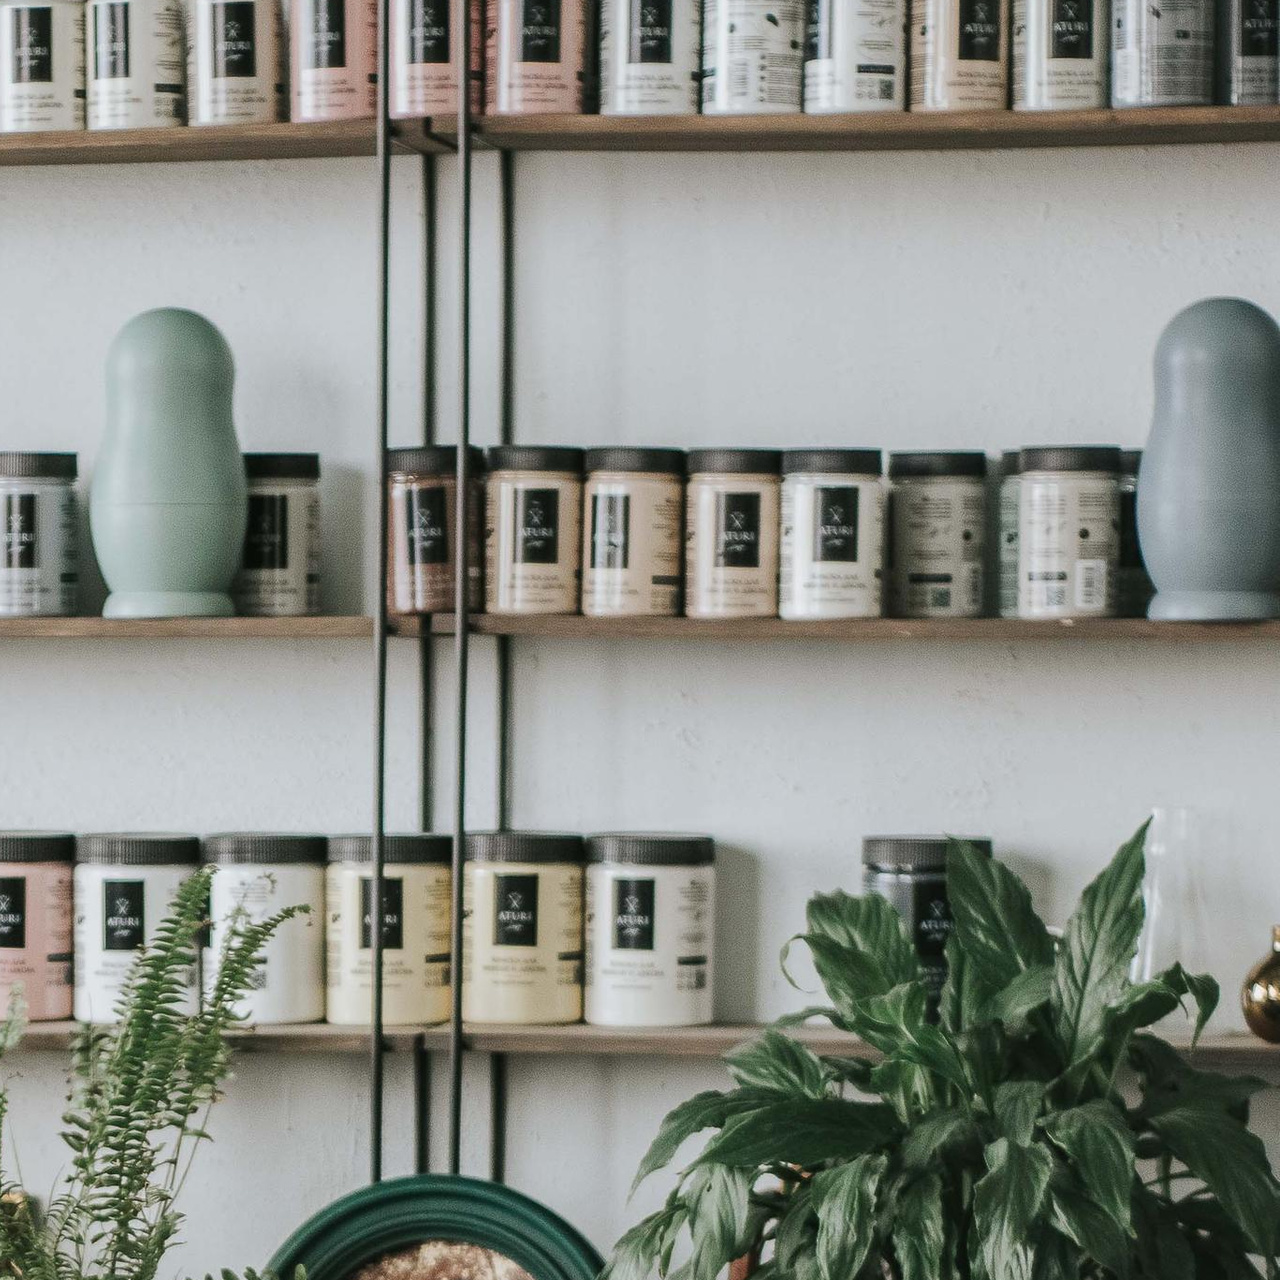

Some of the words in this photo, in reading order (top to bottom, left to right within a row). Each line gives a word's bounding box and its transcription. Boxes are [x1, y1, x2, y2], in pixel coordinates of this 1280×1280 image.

[522, 527, 553, 537] ATURI
[723, 530, 755, 541] ATURI
[820, 525, 853, 536] ATURI
[106, 916, 140, 927] ATURI
[499, 911, 532, 922] ATURI
[617, 915, 650, 926] ATURI
